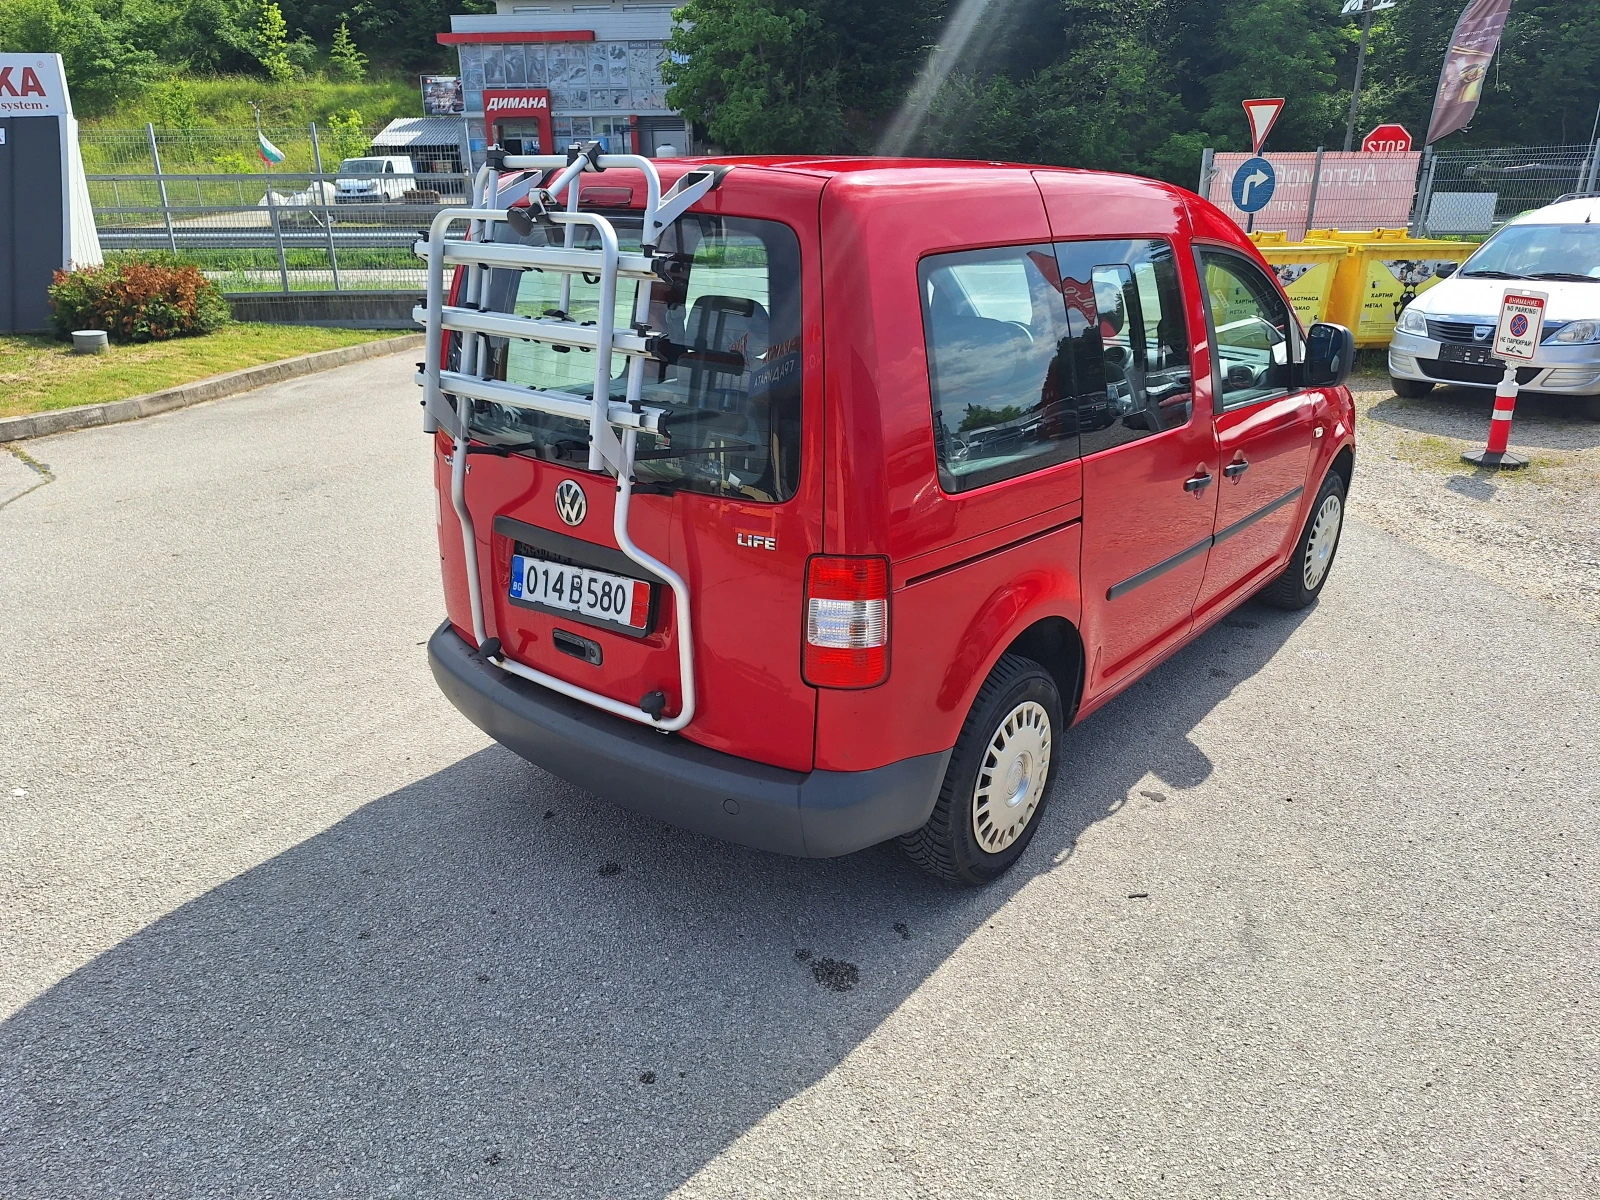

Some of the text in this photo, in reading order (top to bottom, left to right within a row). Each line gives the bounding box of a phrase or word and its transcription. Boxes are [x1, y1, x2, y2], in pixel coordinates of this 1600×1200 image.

[1, 101, 43, 112] system
[486, 97, 547, 111] ДИМАНА
[1367, 139, 1406, 152] STOP
[737, 532, 776, 551] LIFE
[512, 581, 522, 592] BG
